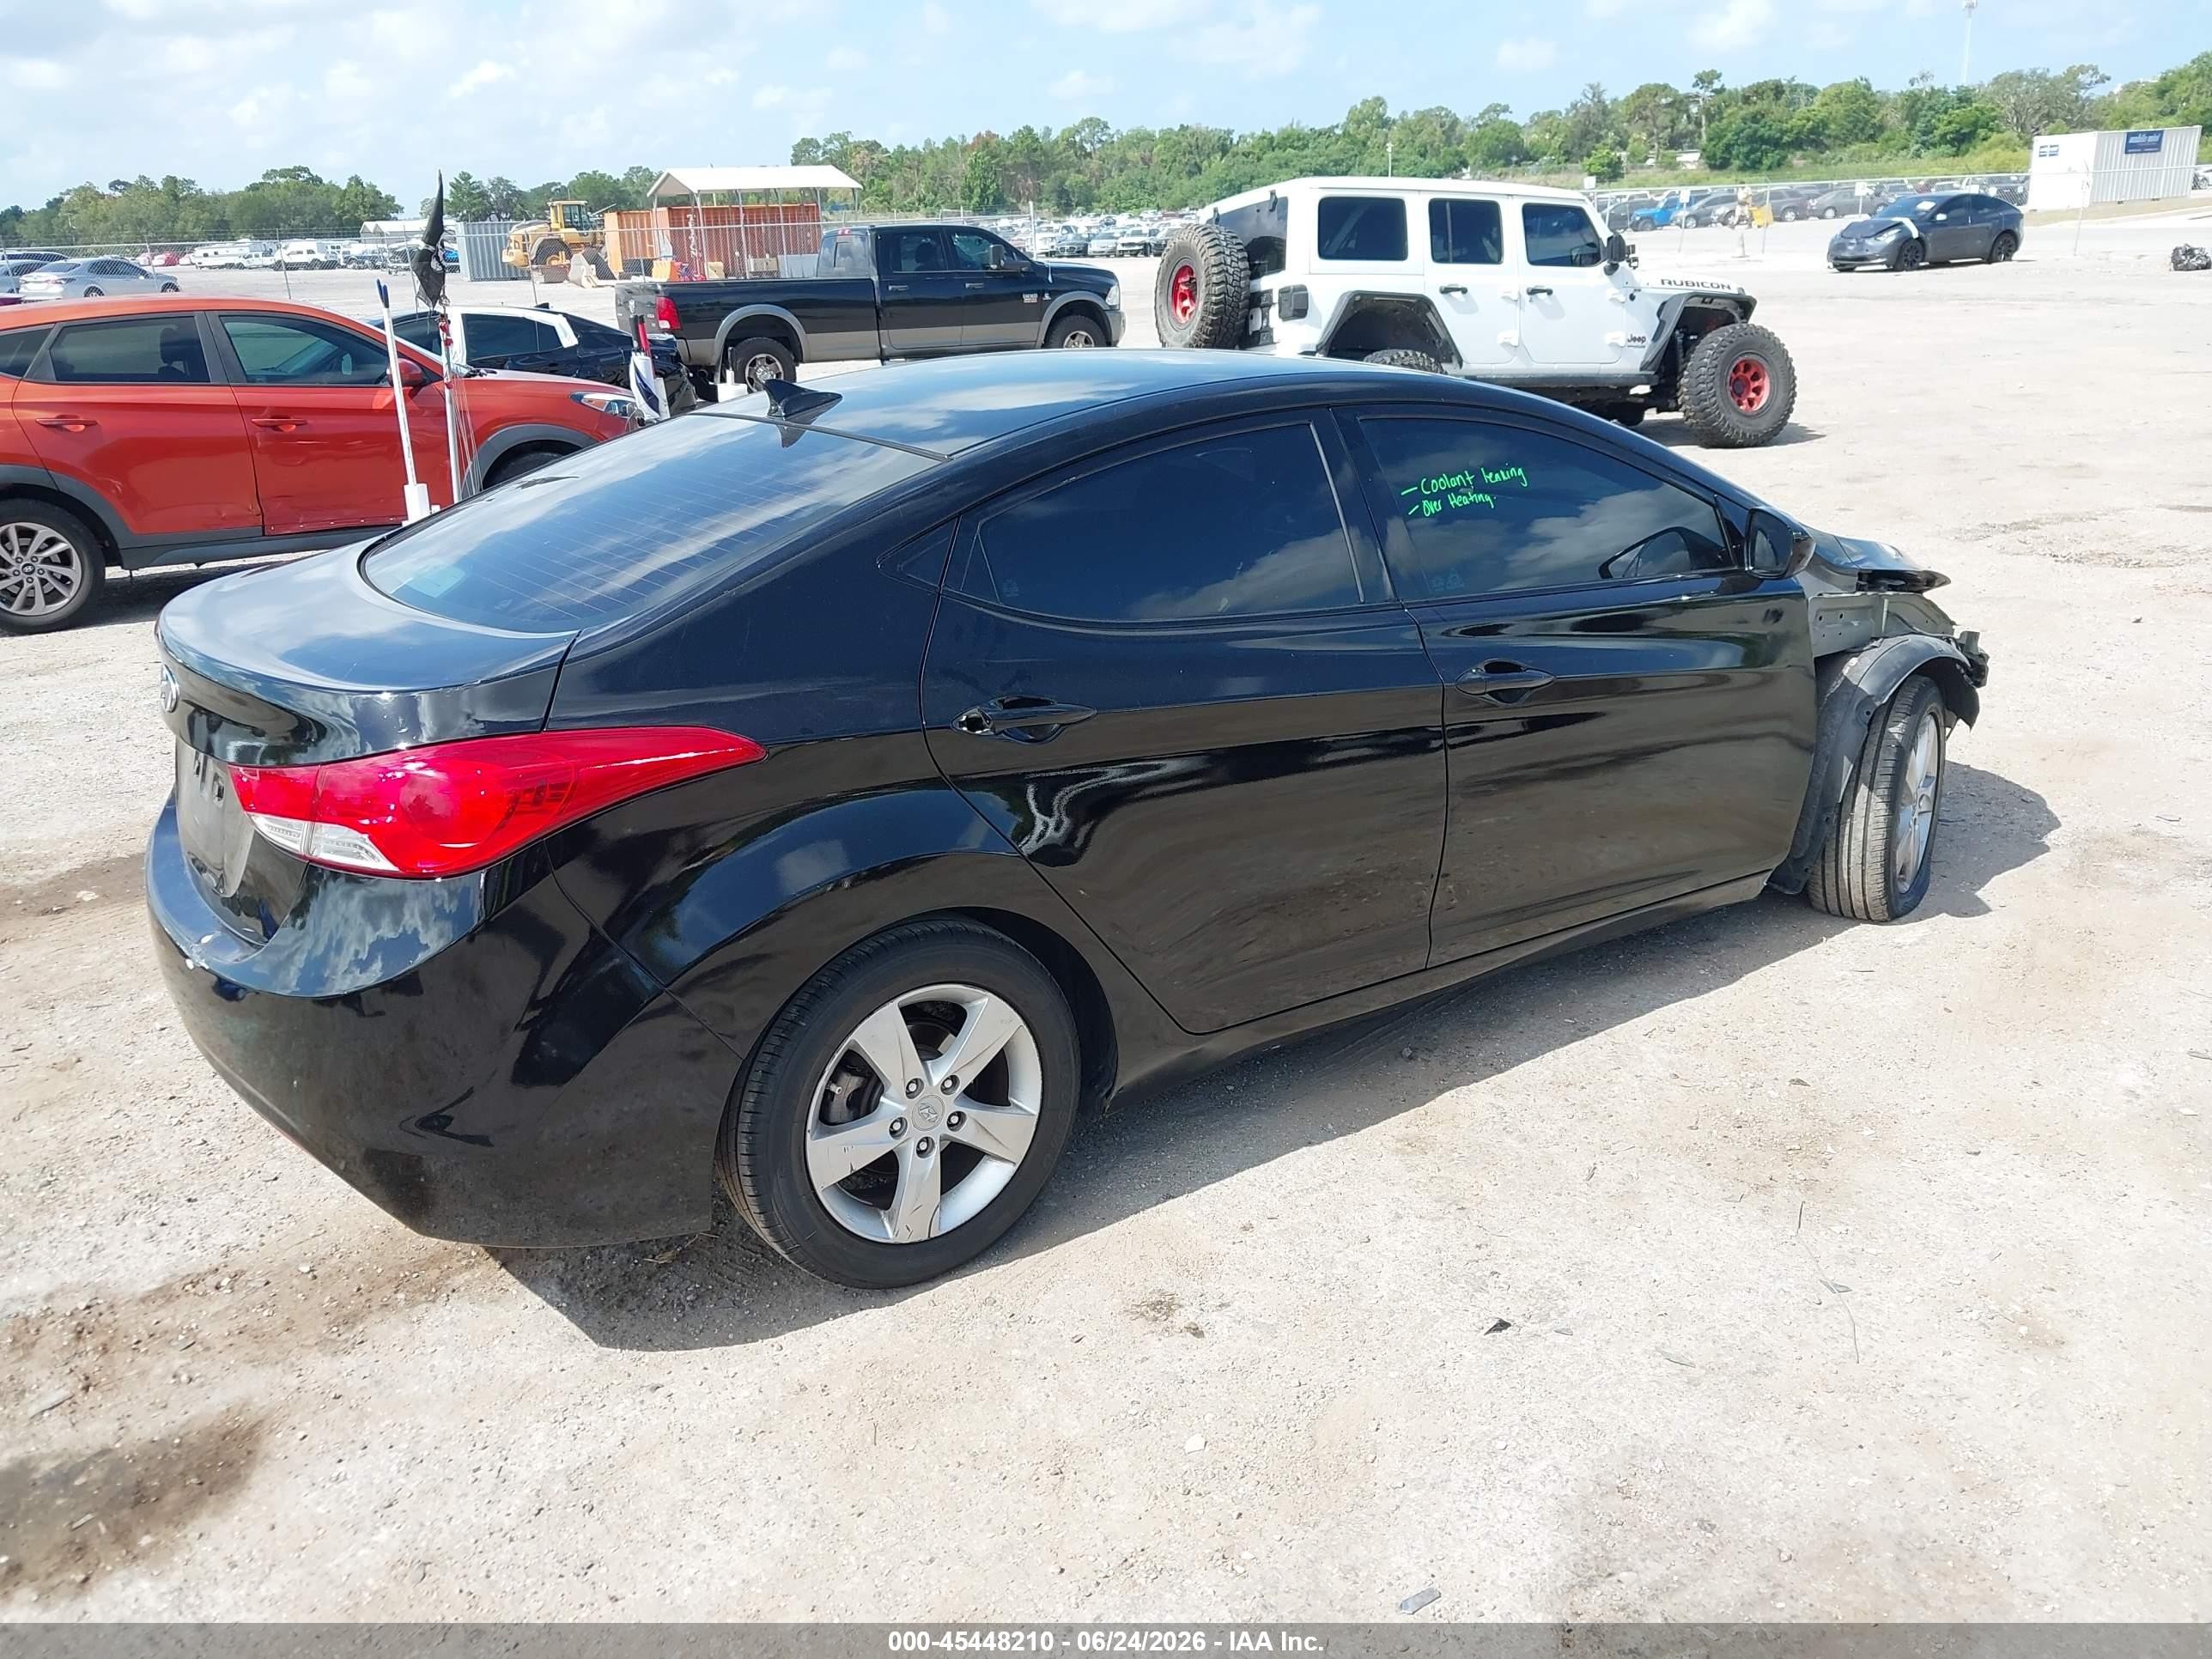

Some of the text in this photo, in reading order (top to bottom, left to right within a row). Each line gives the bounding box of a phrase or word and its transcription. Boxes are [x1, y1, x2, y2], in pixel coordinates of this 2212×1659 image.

[1660, 278, 1732, 290] RUBICON
[1627, 333, 1647, 344] Jeep
[1420, 470, 1475, 495] Coolant
